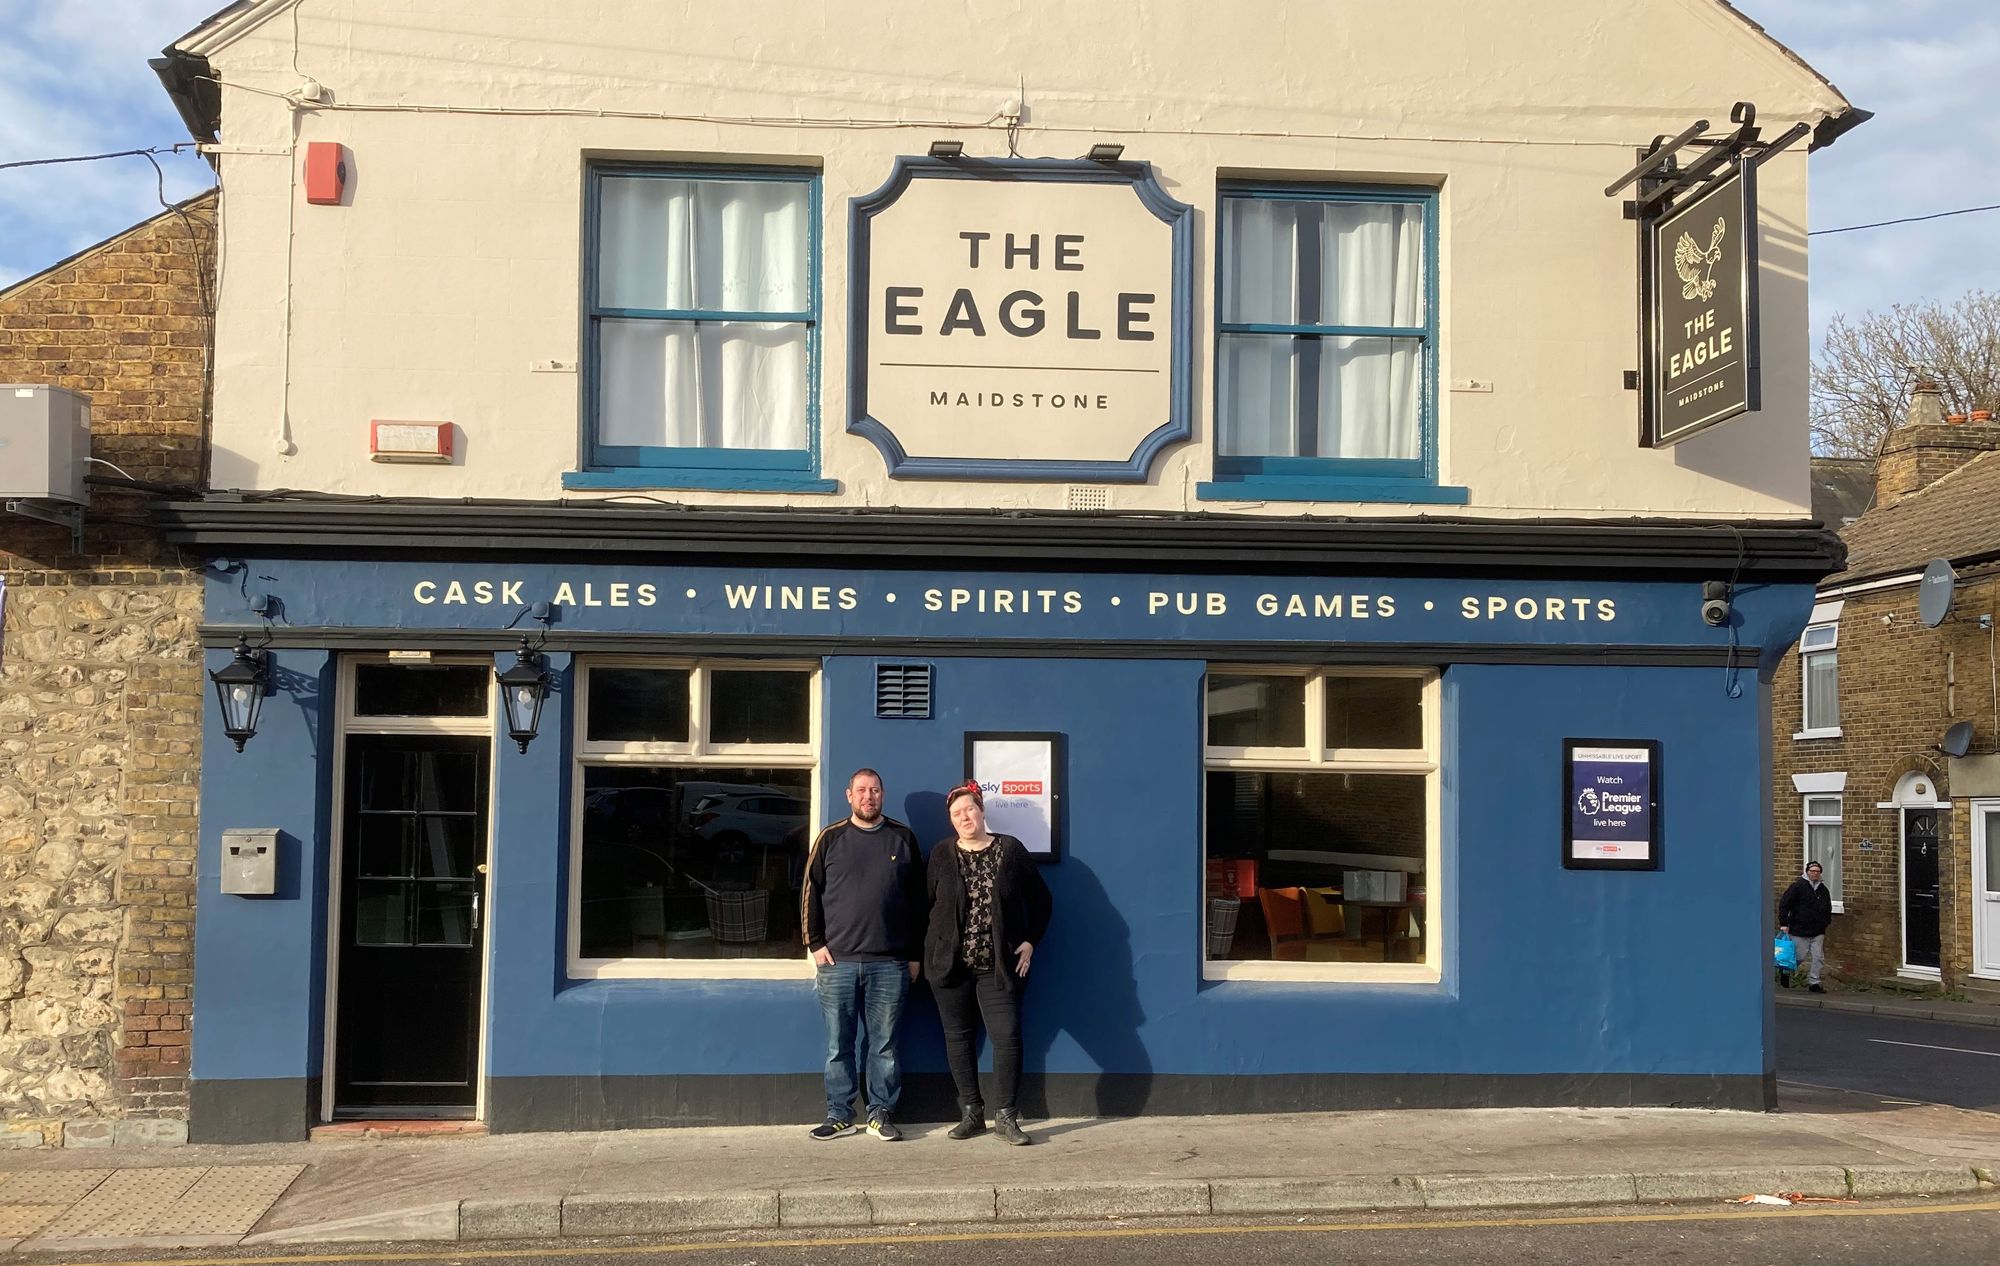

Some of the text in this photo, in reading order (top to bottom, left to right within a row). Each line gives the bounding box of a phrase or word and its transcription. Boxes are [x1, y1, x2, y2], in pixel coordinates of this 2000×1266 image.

[959, 231, 1085, 271] THE
[885, 286, 1156, 342] EAGLE
[1684, 308, 1715, 340] THE
[1670, 327, 1732, 379] EAGLE
[930, 391, 1108, 409] MAIDSTONE
[1678, 380, 1725, 407] MAIDSTONE
[413, 580, 1616, 622] CASK ALES WINES SPIRITS PUB GAMES SPORTS
[981, 782, 1040, 793] sky sports
[1597, 776, 1623, 784] Watch
[995, 801, 1029, 809] live here
[1602, 792, 1641, 802] Premier
[1602, 803, 1642, 814] League
[1594, 818, 1626, 827] live here
